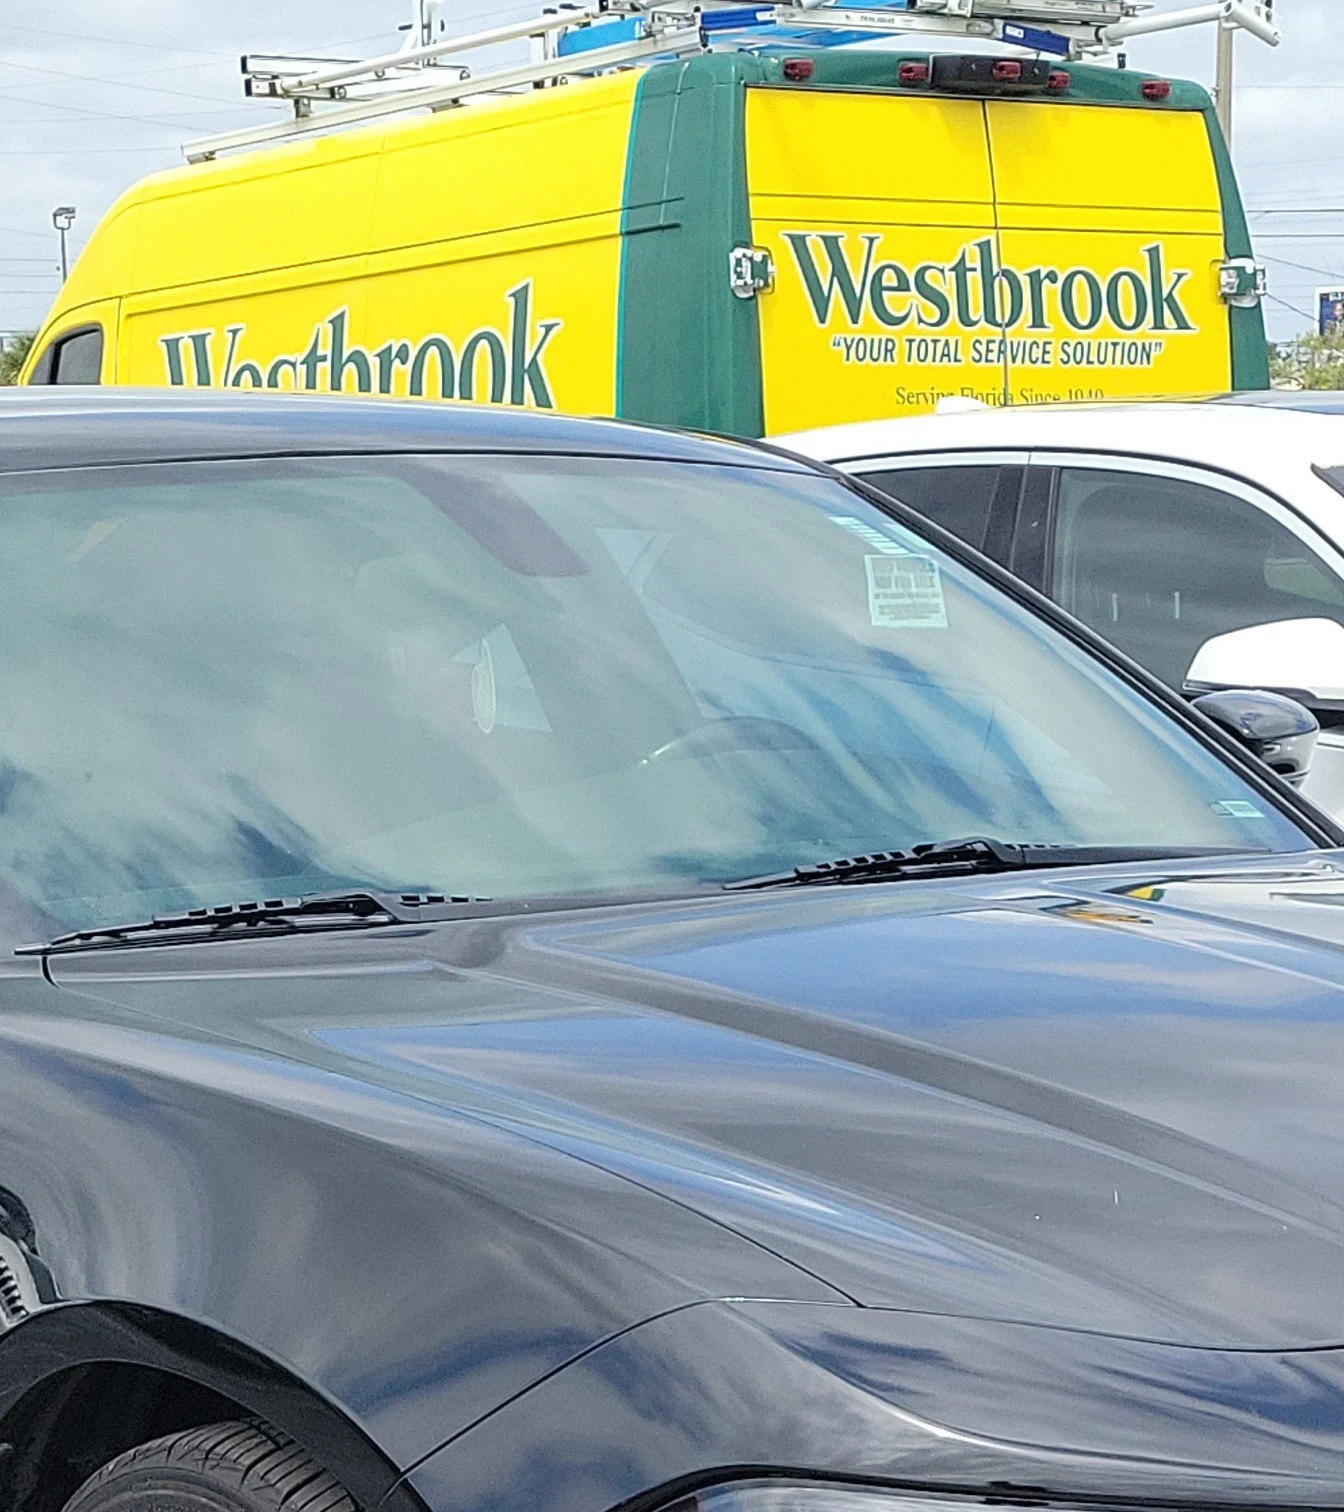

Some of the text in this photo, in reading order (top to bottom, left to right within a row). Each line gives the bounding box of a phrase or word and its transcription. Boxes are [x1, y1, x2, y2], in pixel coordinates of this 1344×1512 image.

[782, 233, 1197, 331] Westbrook
[905, 337, 963, 363] TOTAL
[971, 338, 1053, 365] SERVICE
[895, 386, 955, 405] Servin
